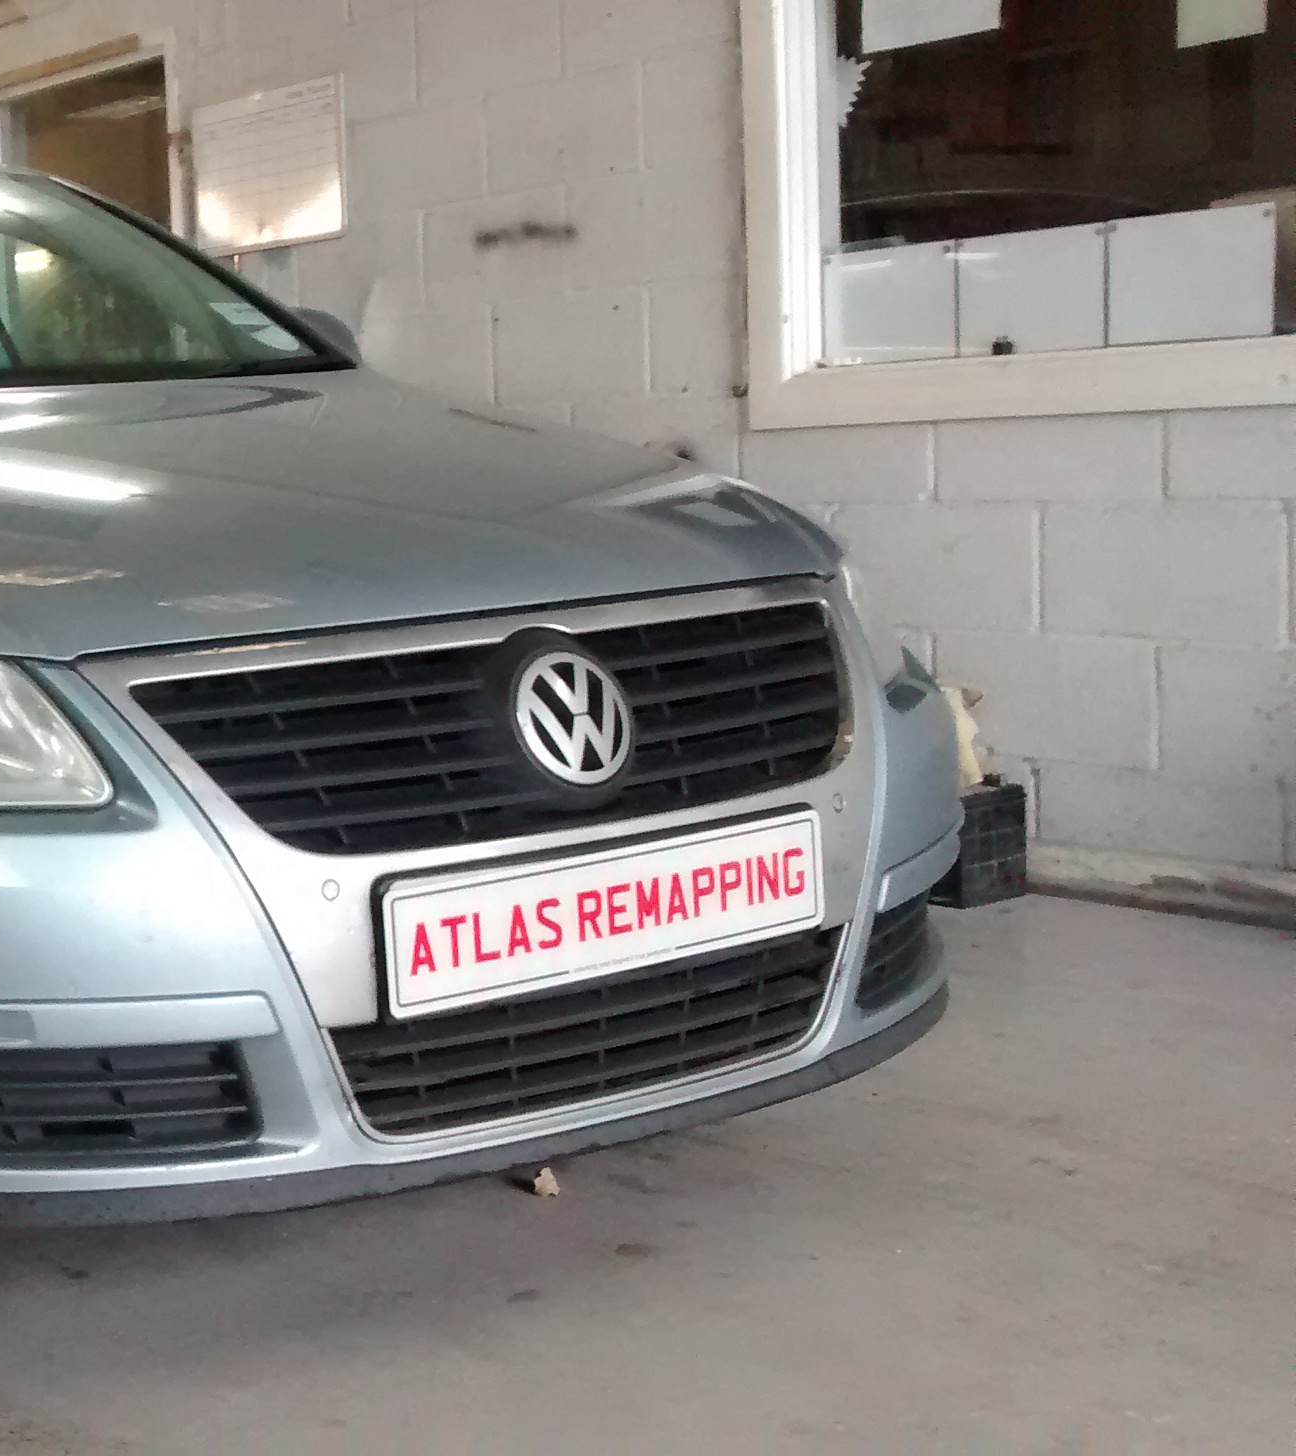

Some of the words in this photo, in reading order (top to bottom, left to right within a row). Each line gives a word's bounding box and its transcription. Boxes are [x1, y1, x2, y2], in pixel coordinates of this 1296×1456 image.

[519, 655, 629, 781] VW
[410, 898, 563, 976] ATLAS
[577, 847, 805, 942] REMAPPING
